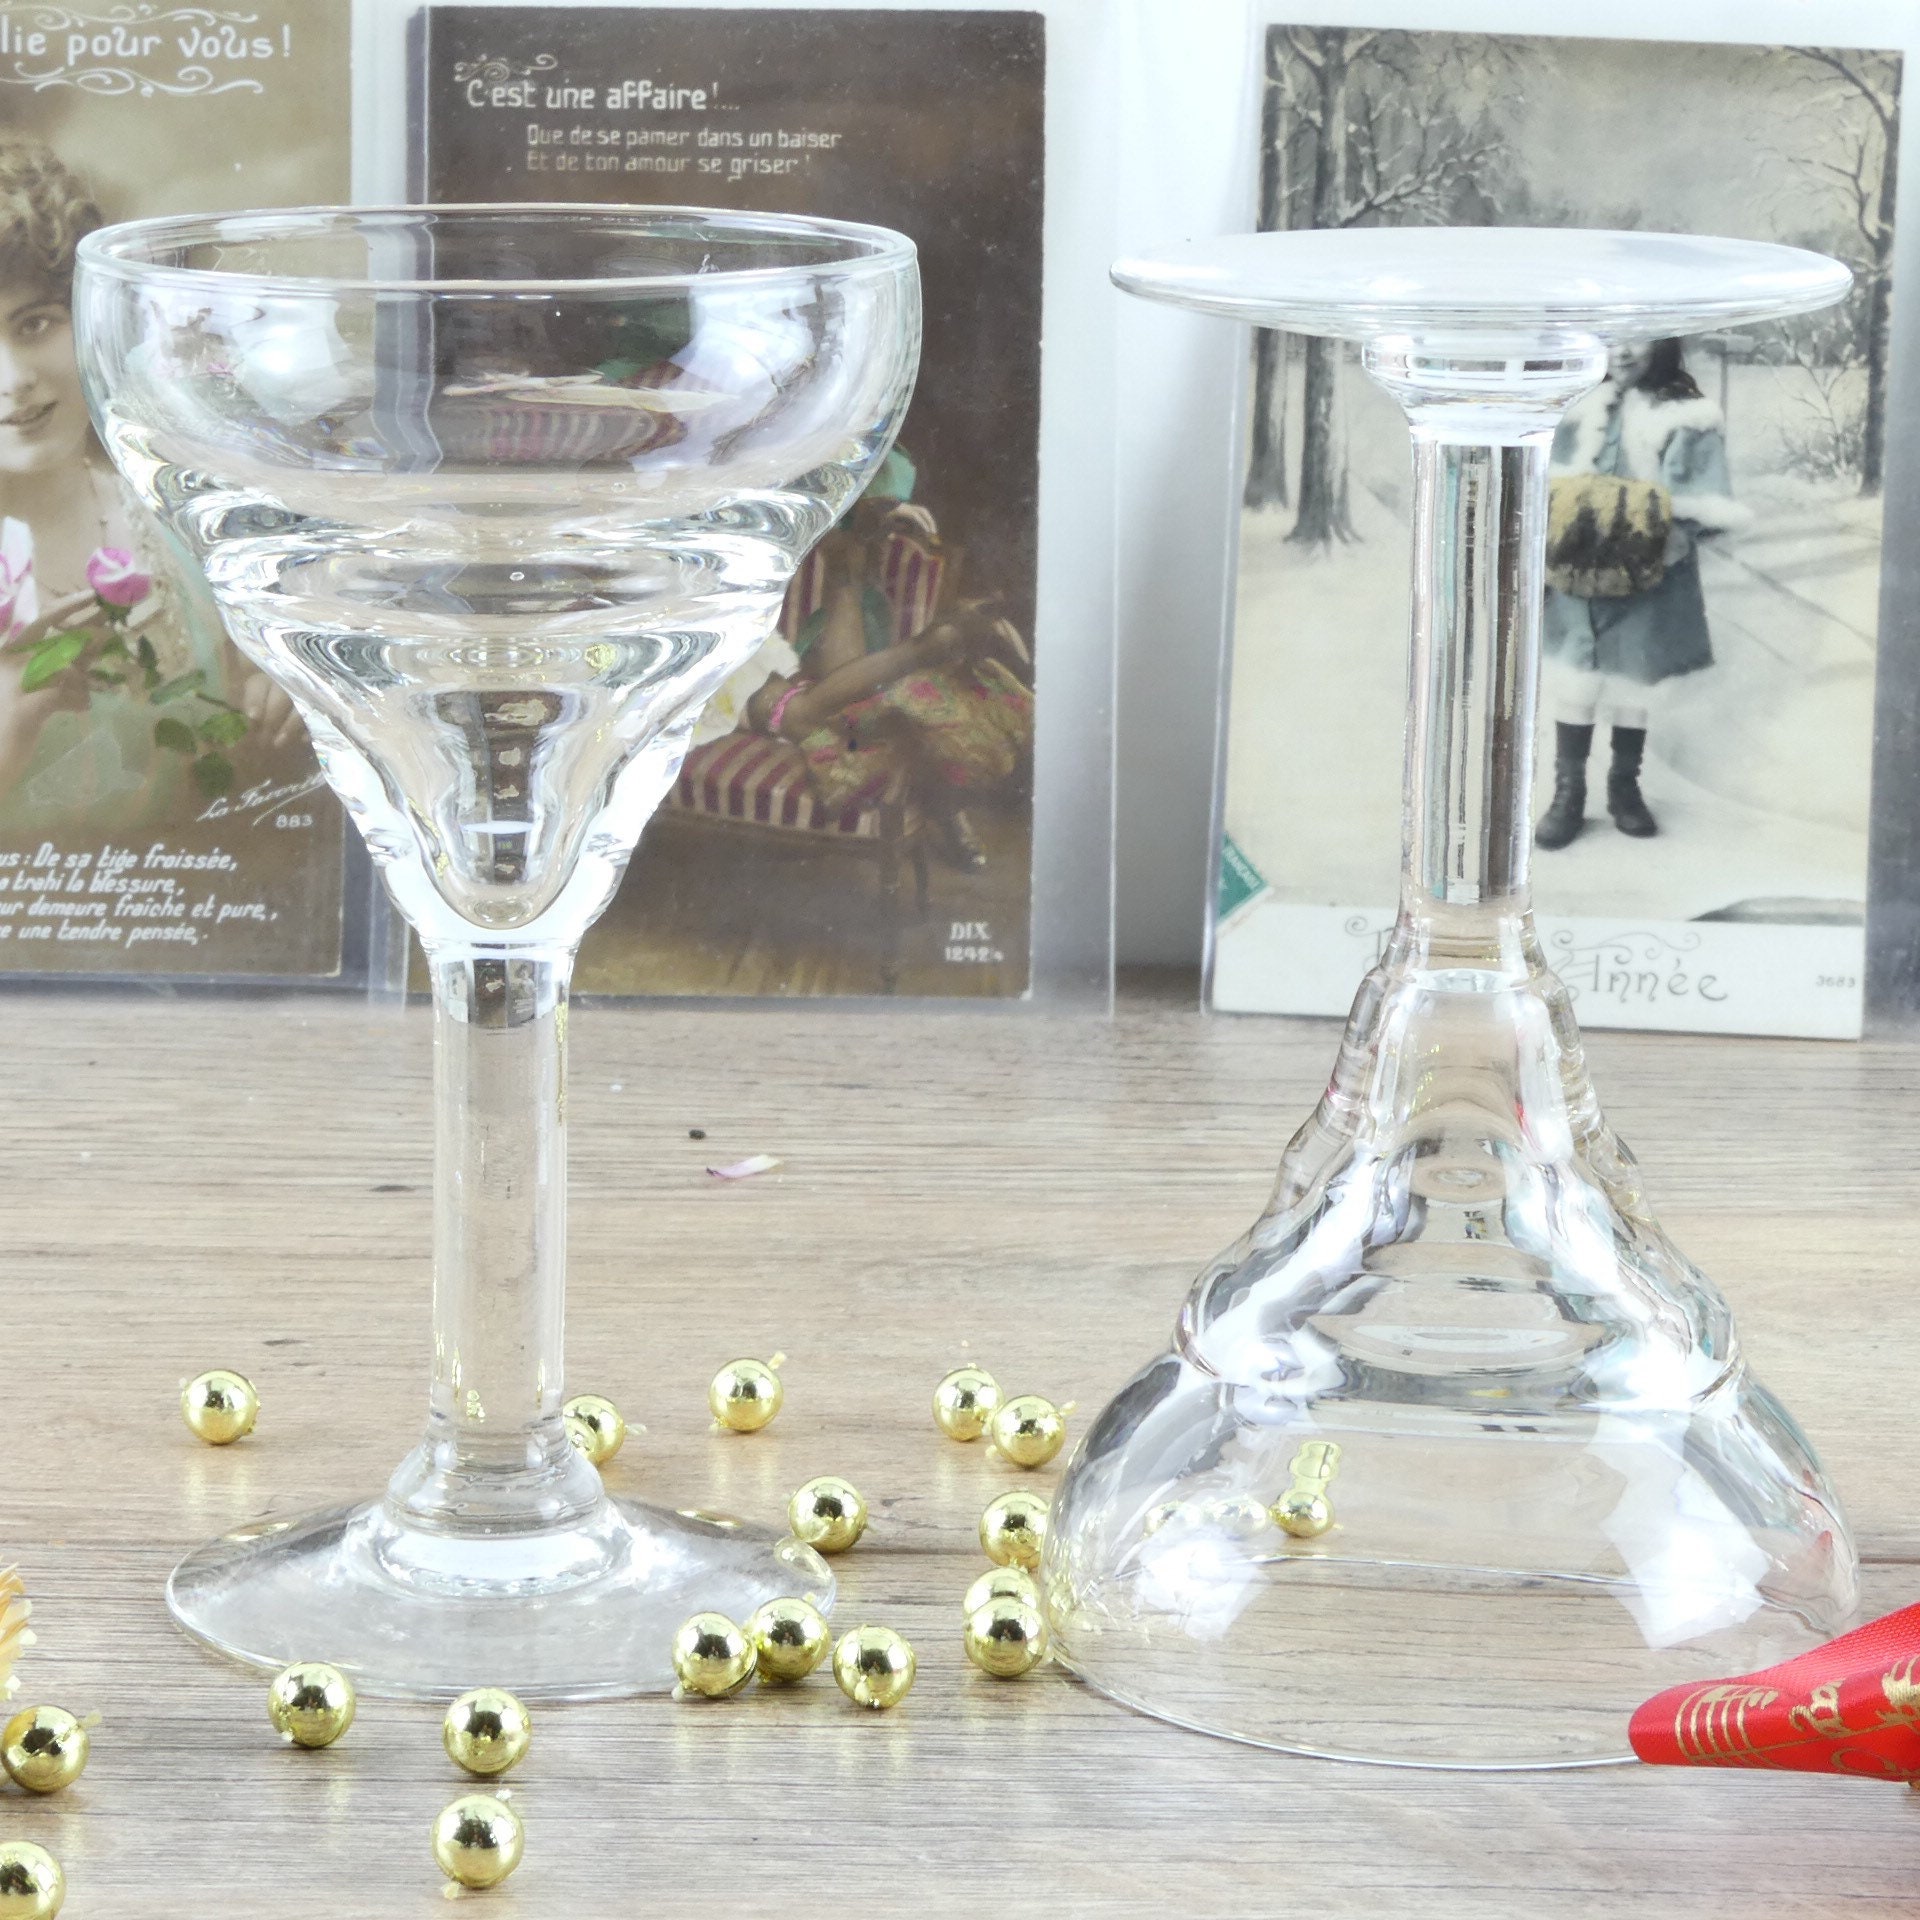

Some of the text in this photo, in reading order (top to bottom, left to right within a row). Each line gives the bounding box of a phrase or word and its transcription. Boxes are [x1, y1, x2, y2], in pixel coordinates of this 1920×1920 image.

[66, 26, 162, 66] pour
[546, 85, 595, 109] une
[527, 124, 564, 146] Que
[569, 124, 593, 145] de
[596, 129, 621, 146] se
[697, 127, 744, 147] dans
[749, 132, 773, 147] un
[777, 127, 843, 148] baiser
[526, 150, 549, 171] Et
[555, 152, 580, 171] de
[585, 152, 620, 171] ton
[624, 155, 692, 172] amour
[697, 157, 723, 173] se
[33, 842, 61, 868] De
[64, 852, 93, 868] sa
[12, 868, 66, 892] trahi
[65, 867, 85, 892] la
[89, 869, 185, 896] blessure,
[27, 893, 109, 917] demeure
[190, 894, 216, 918] et
[18, 926, 53, 940] une
[56, 918, 123, 940] tendre
[948, 921, 991, 941] DIX
